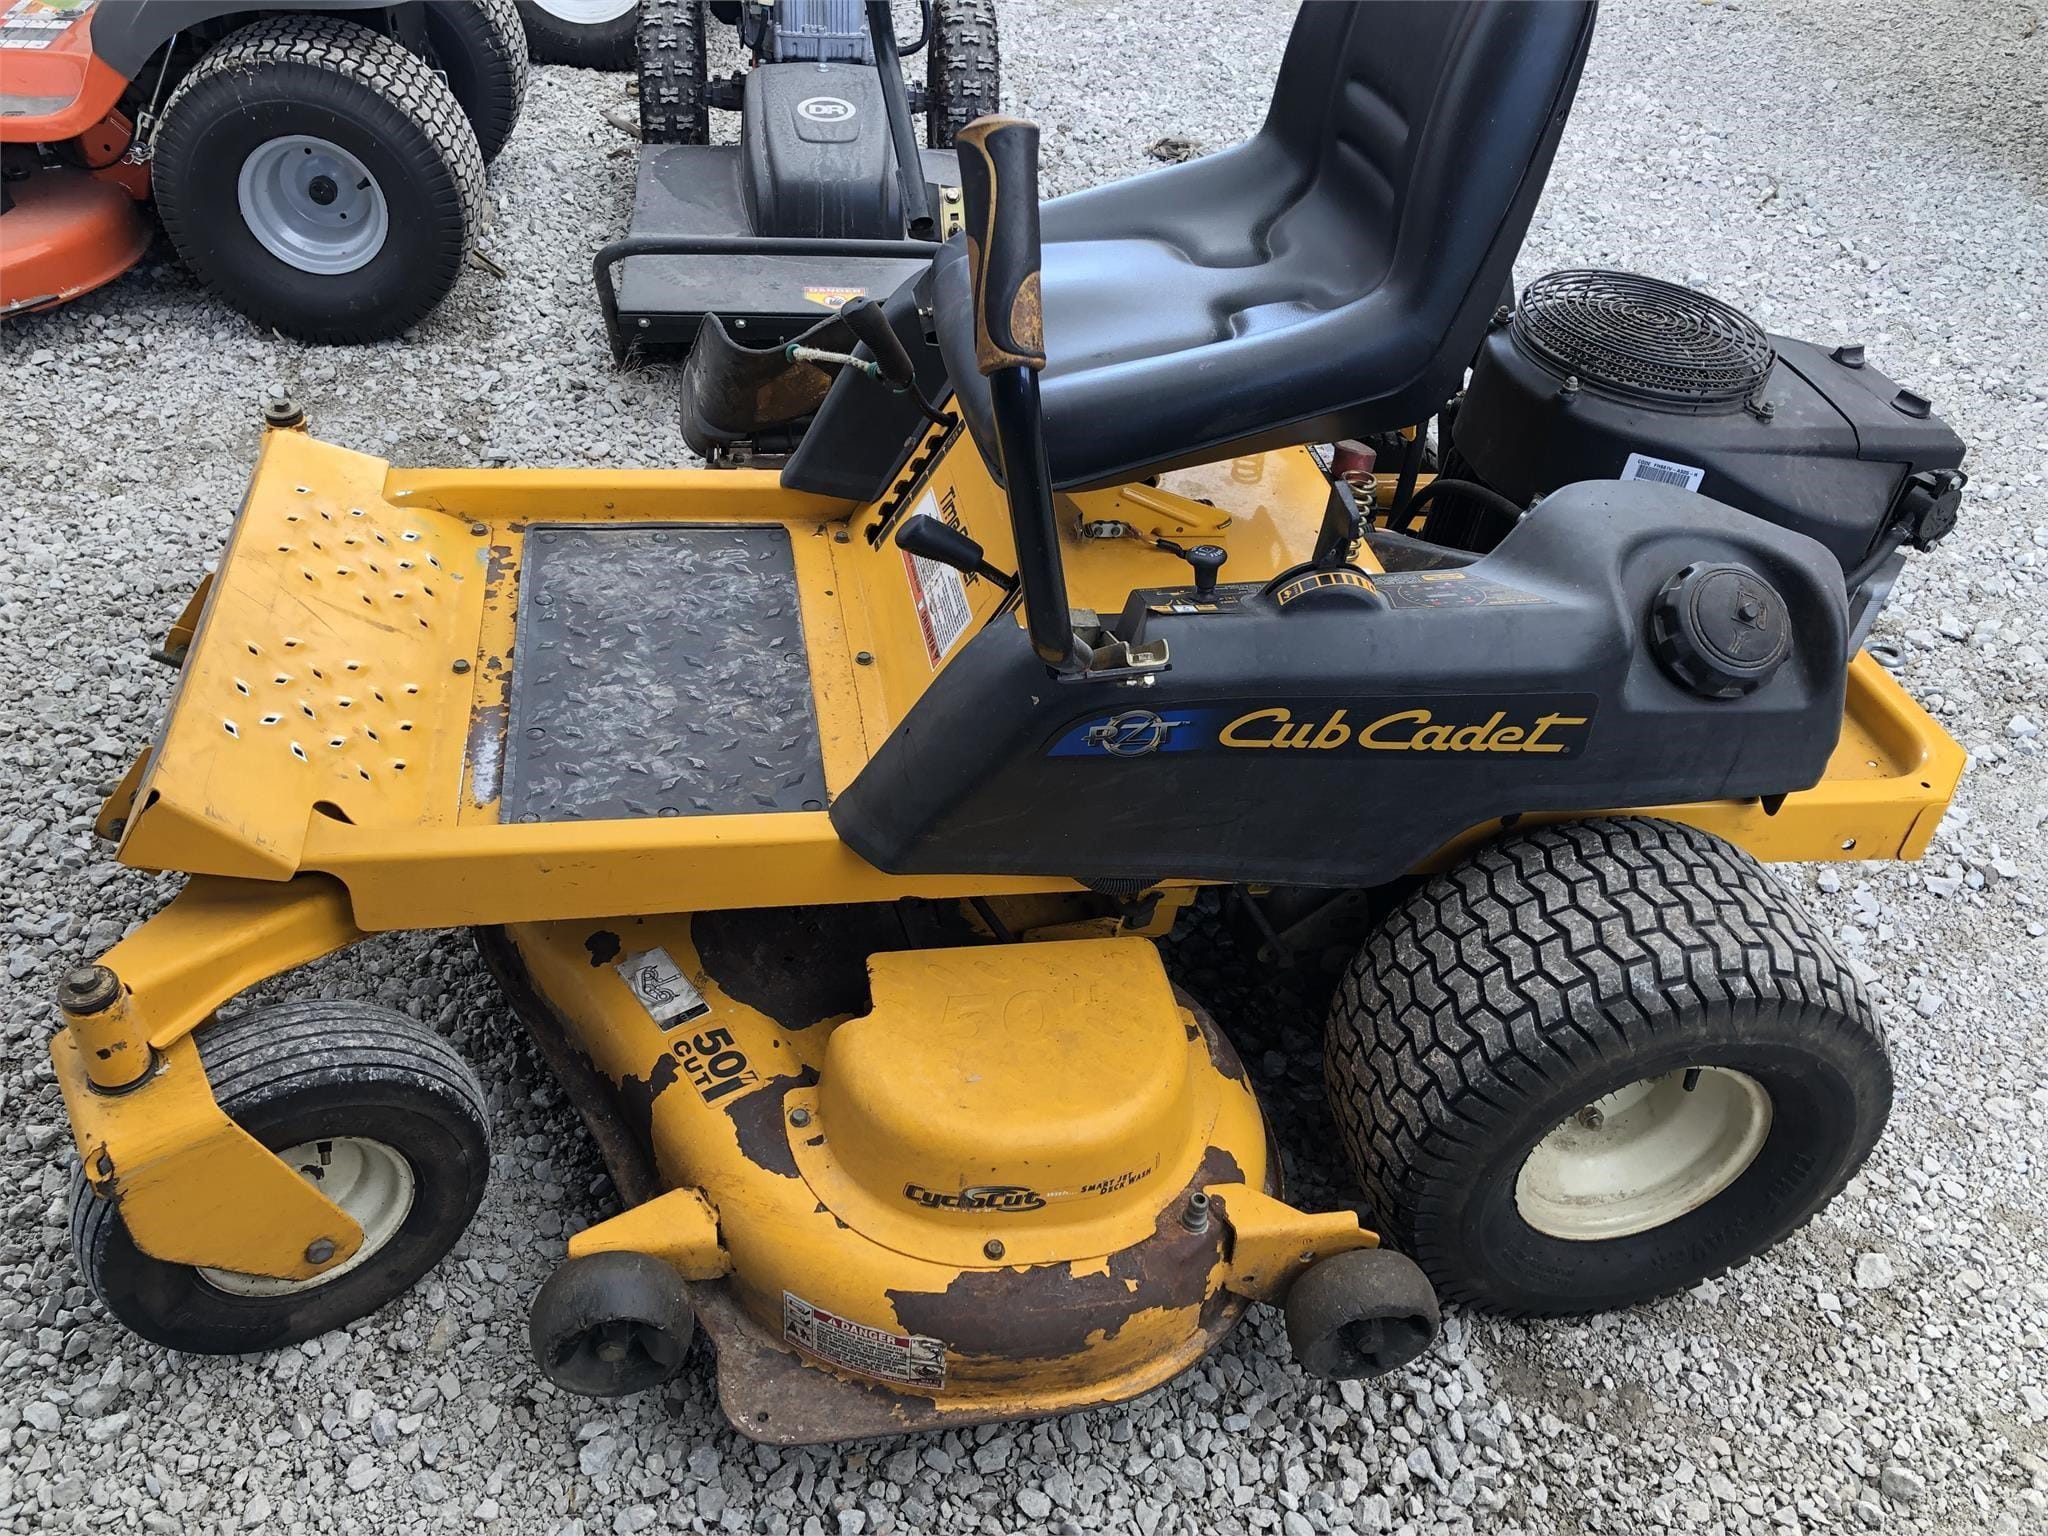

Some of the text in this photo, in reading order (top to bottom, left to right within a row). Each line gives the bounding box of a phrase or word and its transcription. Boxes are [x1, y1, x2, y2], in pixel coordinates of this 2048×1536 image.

[808, 104, 846, 115] DR
[1219, 708, 1588, 753] Cub Cadet
[673, 1040, 712, 1086] CUT
[1081, 1172, 1133, 1193] SMART JET
[1100, 1167, 1151, 1195] DECK WASH
[841, 1322, 896, 1345] DANGER
